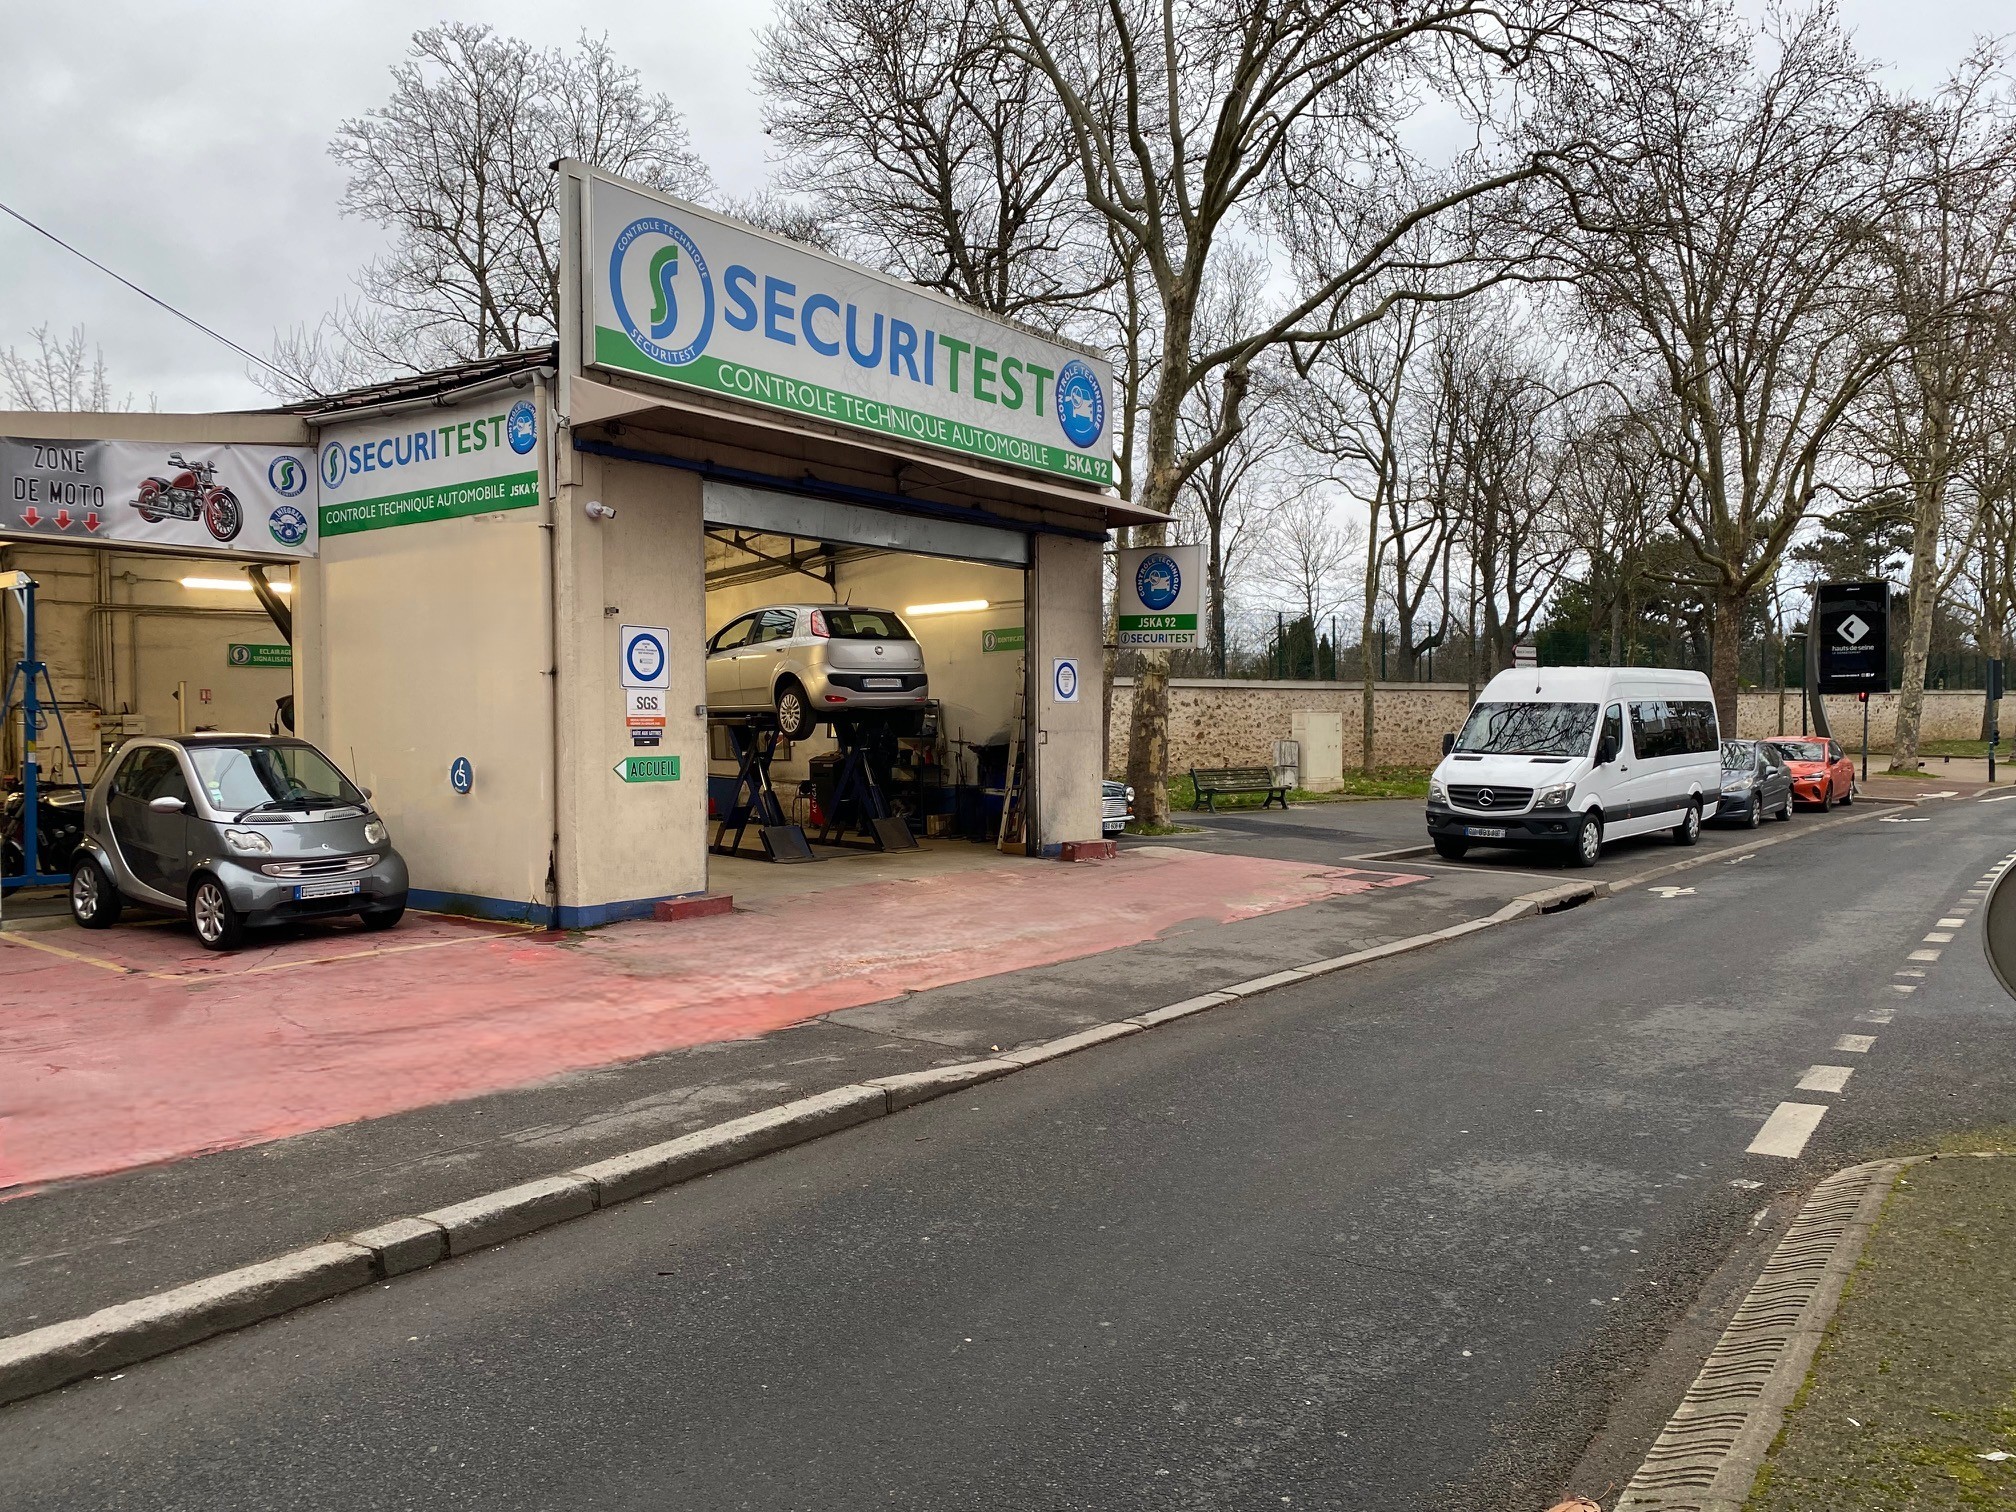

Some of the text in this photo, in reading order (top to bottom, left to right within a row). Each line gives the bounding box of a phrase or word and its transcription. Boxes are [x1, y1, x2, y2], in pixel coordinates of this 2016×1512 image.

[617, 221, 708, 279] CONTROLE TECHNIQUE
[630, 328, 696, 363] SECURITEST
[723, 264, 1055, 418] SECURITEST
[1080, 366, 1103, 431] TECHNIQUE
[718, 363, 1108, 479] CONTROLE TECHNIQUE AUTOMOBILE JSKA 92
[32, 444, 86, 474] ZONE
[349, 414, 506, 475] SECURITEST
[13, 475, 106, 509] DE MOTO
[325, 504, 376, 524] CONTROLE
[378, 495, 435, 517] TECHNIQUE
[436, 483, 506, 508] AUTOMOBILE
[509, 483, 531, 497] JSKA
[274, 506, 302, 521] INTEGRAL
[1157, 556, 1182, 597] TECHNIQUE
[1130, 633, 1196, 643] SECURITEST
[1138, 617, 1176, 628] JSKA 92
[636, 696, 658, 710] SGS
[630, 761, 677, 777] ACCUEIL
